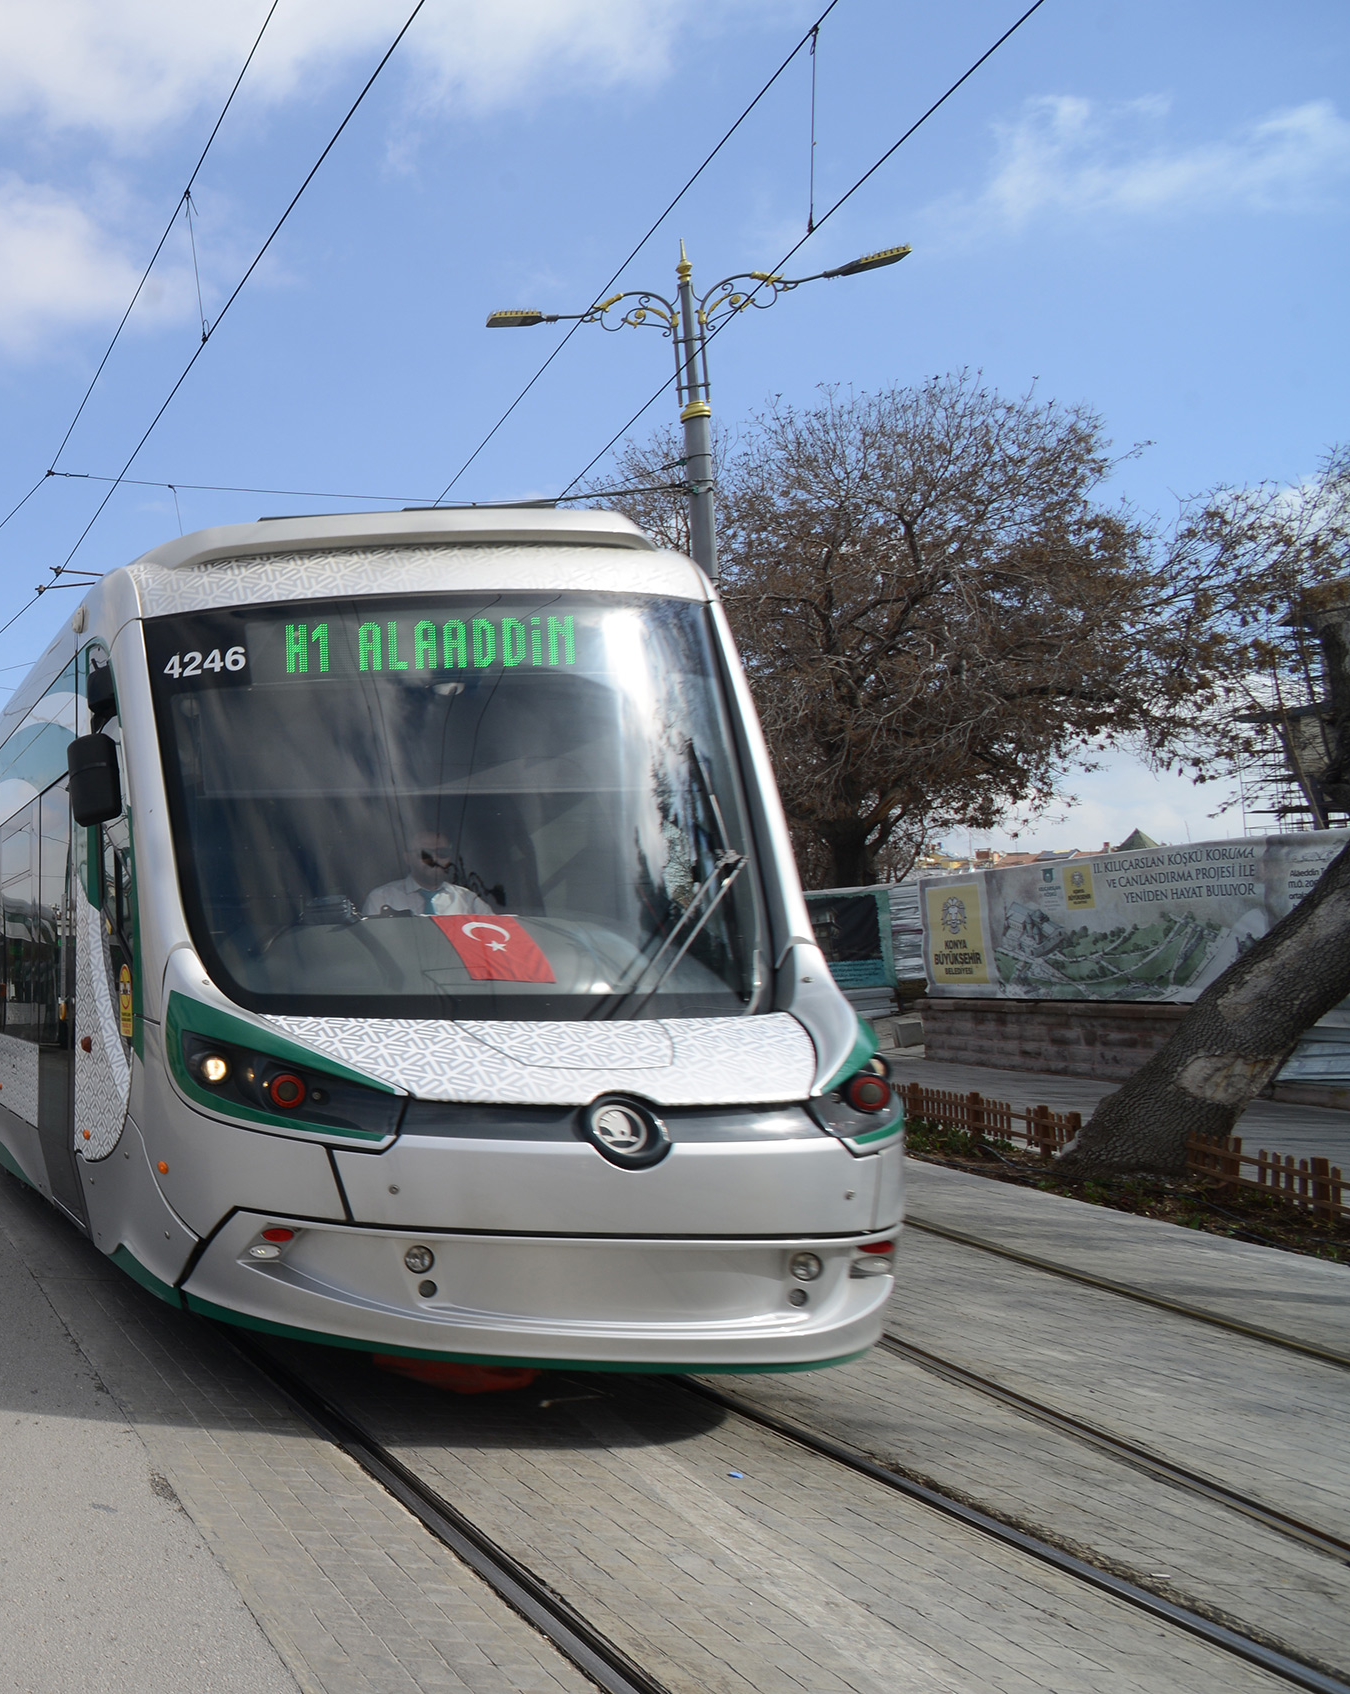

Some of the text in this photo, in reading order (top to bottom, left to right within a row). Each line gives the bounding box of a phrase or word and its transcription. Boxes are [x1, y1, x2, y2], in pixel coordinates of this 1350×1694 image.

[285, 623, 329, 673] H1
[163, 646, 247, 679] 4246
[1104, 855, 1165, 874] KILIÇARSLAN
[1167, 850, 1203, 867] KÖŞKÜ
[1206, 847, 1255, 862] KORUMA
[1106, 863, 1255, 889] VE CANLANDIRMA PROJESİ İLE
[1123, 883, 1257, 904] YENİDEN HAYAT BULUYOR
[934, 949, 983, 966] BÜYÜKŞEHİR
[944, 939, 968, 950] KONYA
